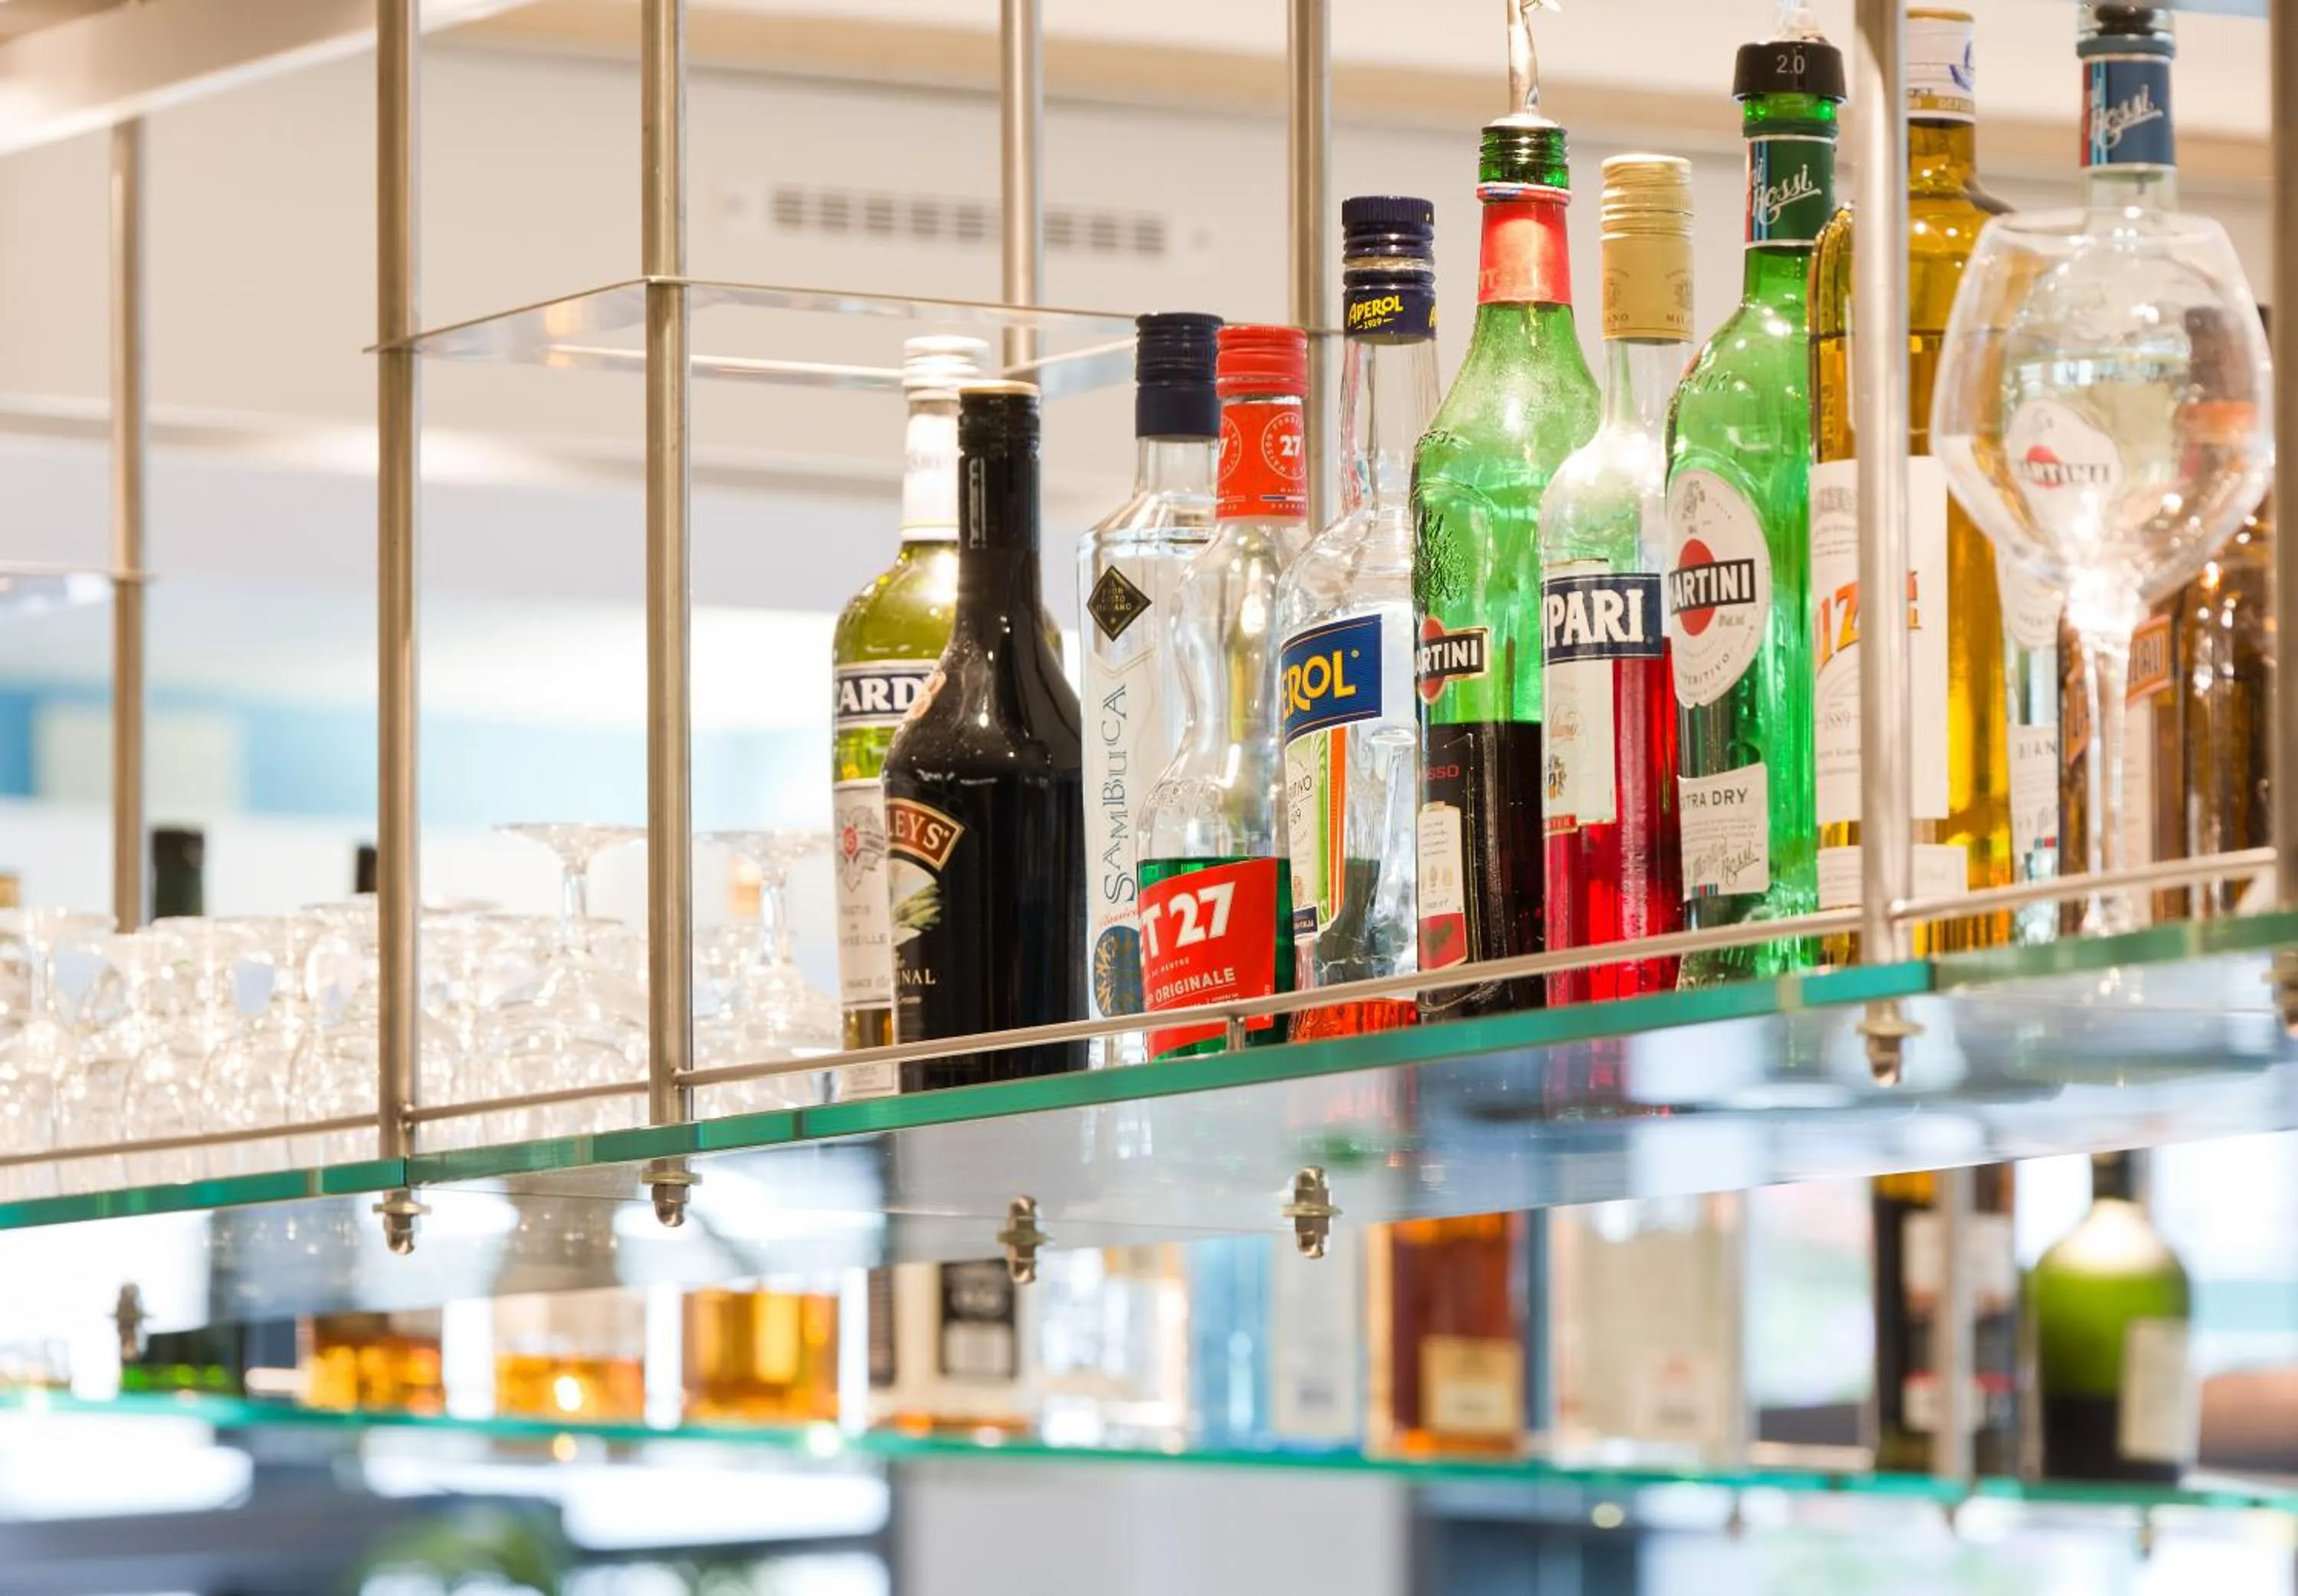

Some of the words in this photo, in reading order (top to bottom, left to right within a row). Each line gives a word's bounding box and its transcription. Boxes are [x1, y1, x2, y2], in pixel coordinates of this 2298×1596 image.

[1776, 54, 1805, 74] 2.0
[1753, 163, 1822, 225] Rossi
[1348, 295, 1404, 328] APEROL
[1278, 434, 1301, 457] 27
[1101, 682, 1136, 904] SAMBUCA
[1712, 786, 1749, 806] DRY
[1168, 881, 1236, 948] 27
[1155, 967, 1236, 1003] ORIGINALE
